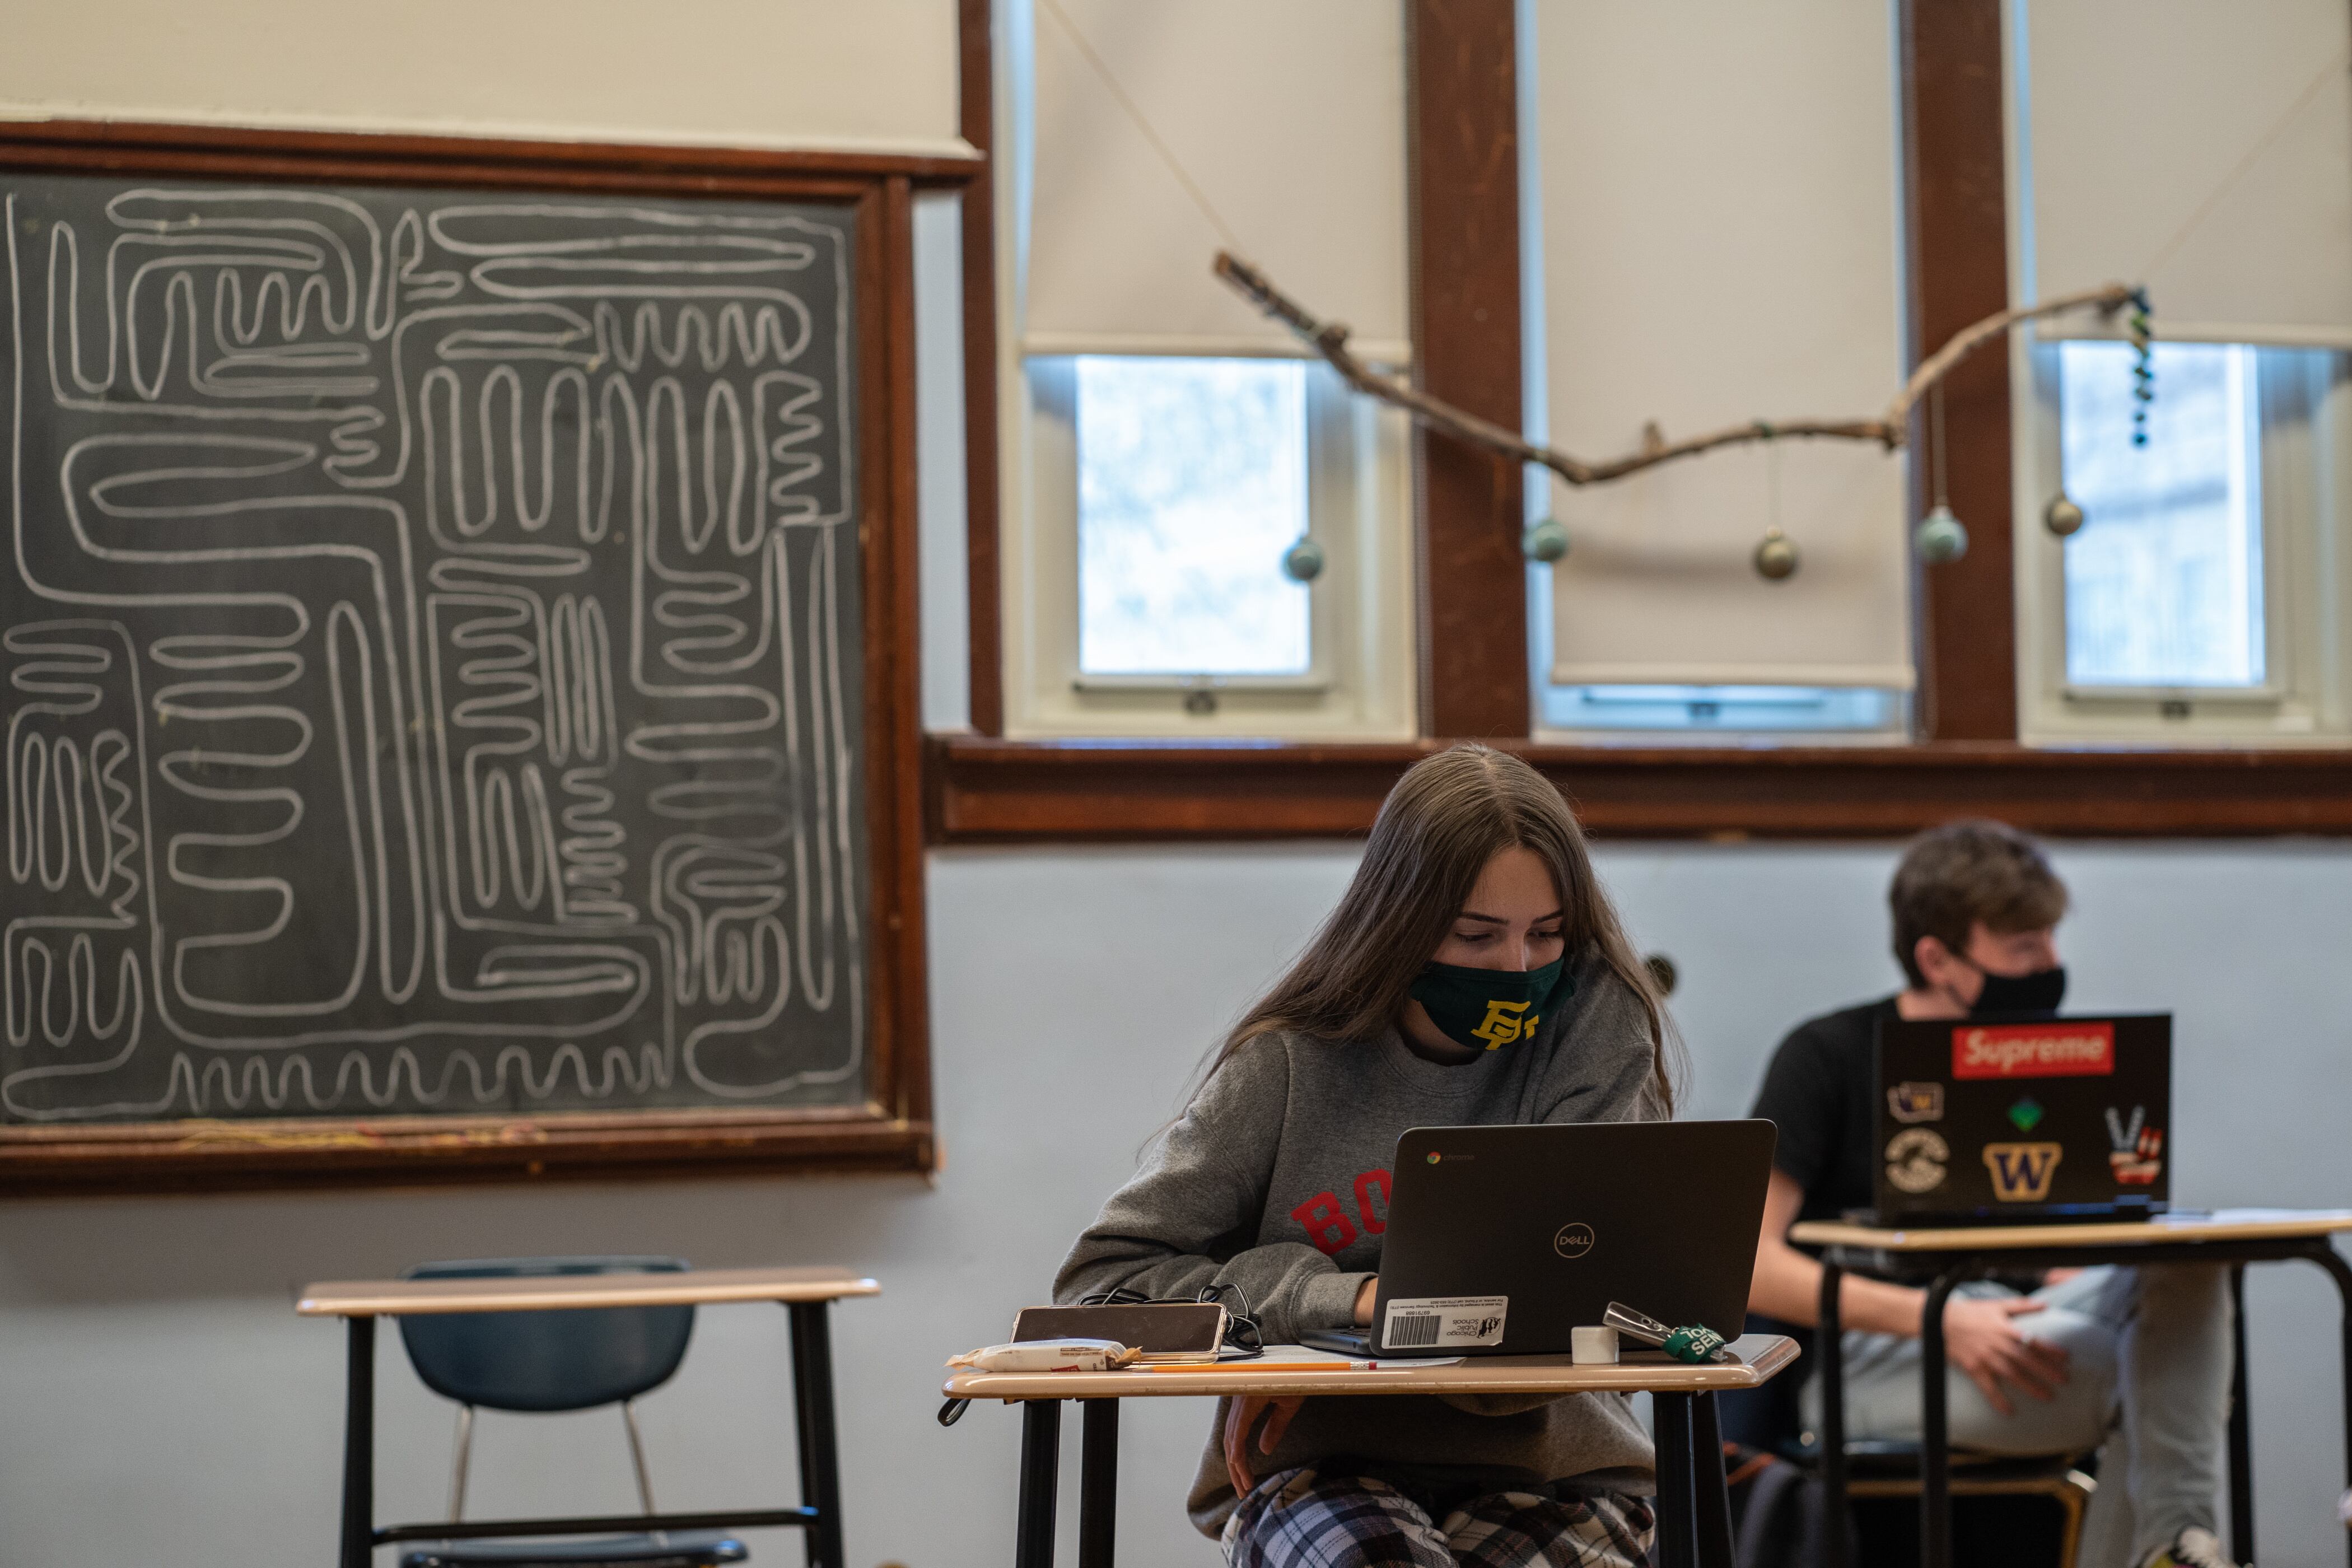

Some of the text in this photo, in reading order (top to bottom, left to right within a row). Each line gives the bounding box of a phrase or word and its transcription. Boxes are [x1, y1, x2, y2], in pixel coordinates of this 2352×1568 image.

[1965, 1028, 2106, 1075] Supreme
[1989, 1147, 2057, 1197] W
[1560, 1236, 1590, 1245] DELL
